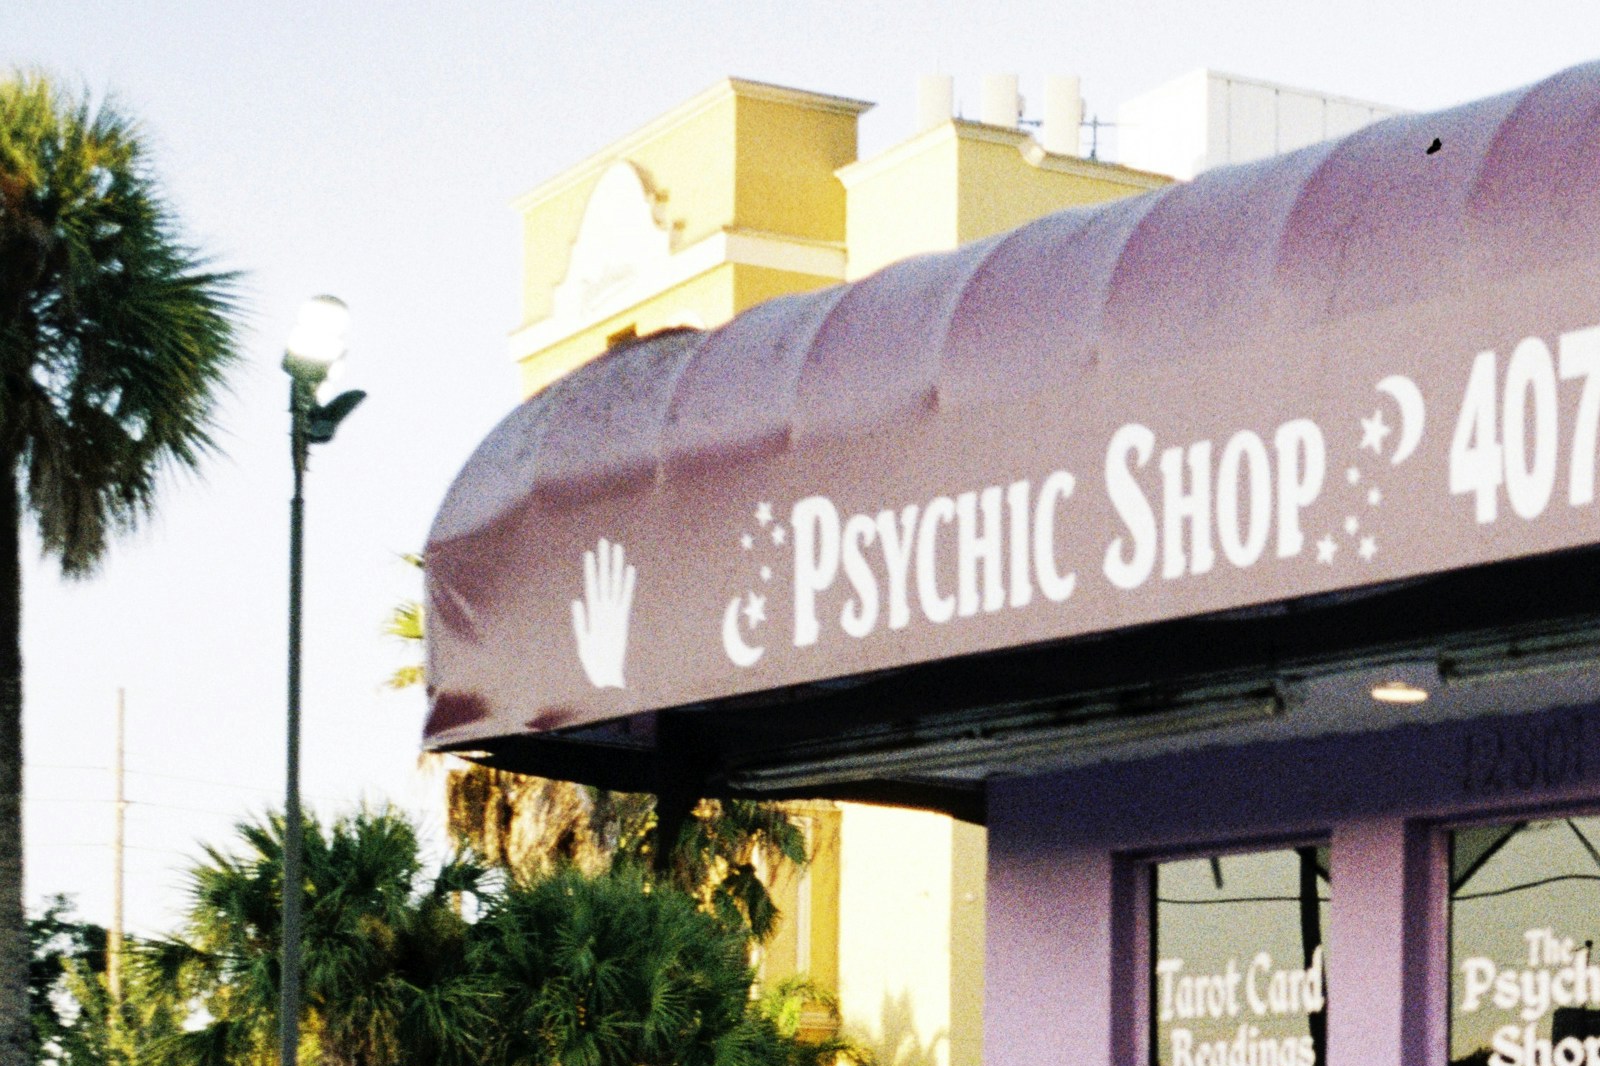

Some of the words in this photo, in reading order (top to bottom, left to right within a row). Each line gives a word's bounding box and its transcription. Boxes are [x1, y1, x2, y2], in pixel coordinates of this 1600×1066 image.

[793, 470, 1076, 647] PSYCHIC
[1102, 419, 1326, 589] SHOP
[1156, 957, 1242, 1022] Tarot
[1245, 944, 1325, 1016] Card
[1524, 927, 1575, 966] The
